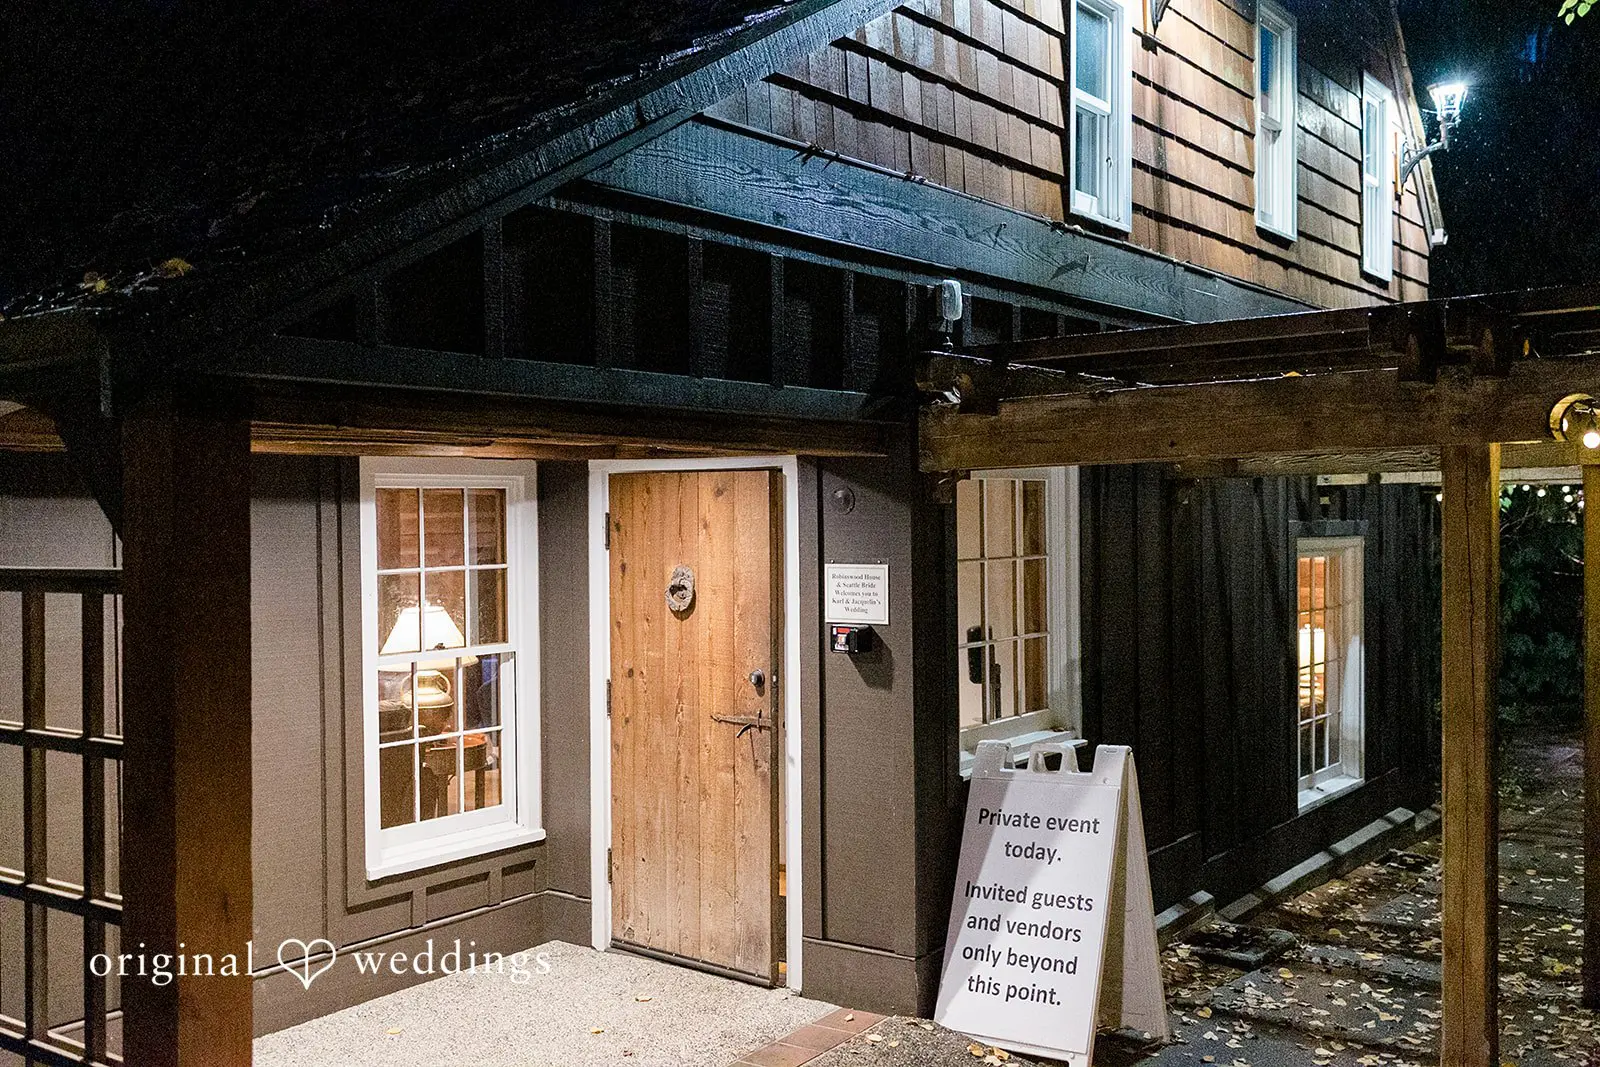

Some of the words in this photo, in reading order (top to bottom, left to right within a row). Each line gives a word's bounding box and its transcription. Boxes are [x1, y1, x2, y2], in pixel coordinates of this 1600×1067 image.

[978, 808, 1041, 829] Private
[1046, 817, 1100, 834] event
[1005, 842, 1062, 864] today.
[965, 881, 1027, 904] Invited
[1032, 892, 1094, 912] guests
[967, 914, 1001, 932] and
[1007, 918, 1082, 943] vendors
[963, 944, 1002, 967] only
[1007, 948, 1078, 975] beyond
[968, 975, 1000, 996] this
[1006, 984, 1061, 1006] point.
